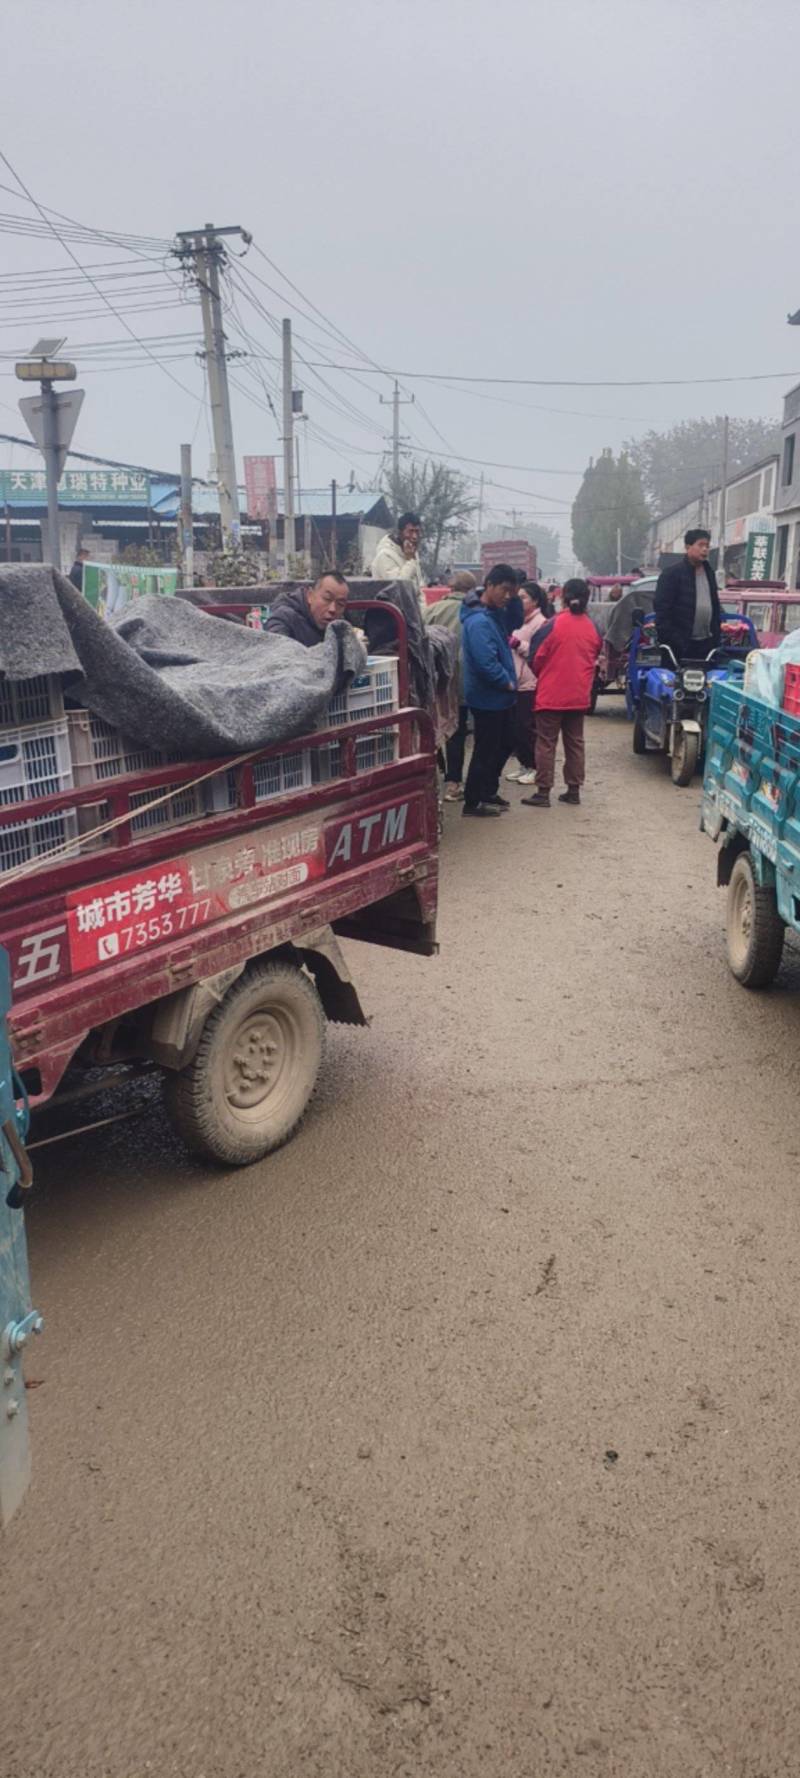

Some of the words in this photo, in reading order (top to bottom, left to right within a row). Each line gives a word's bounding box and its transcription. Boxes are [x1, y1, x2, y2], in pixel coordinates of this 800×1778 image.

[328, 803, 409, 868] ATM
[75, 873, 183, 932] 城市芳华
[13, 925, 66, 989] 五
